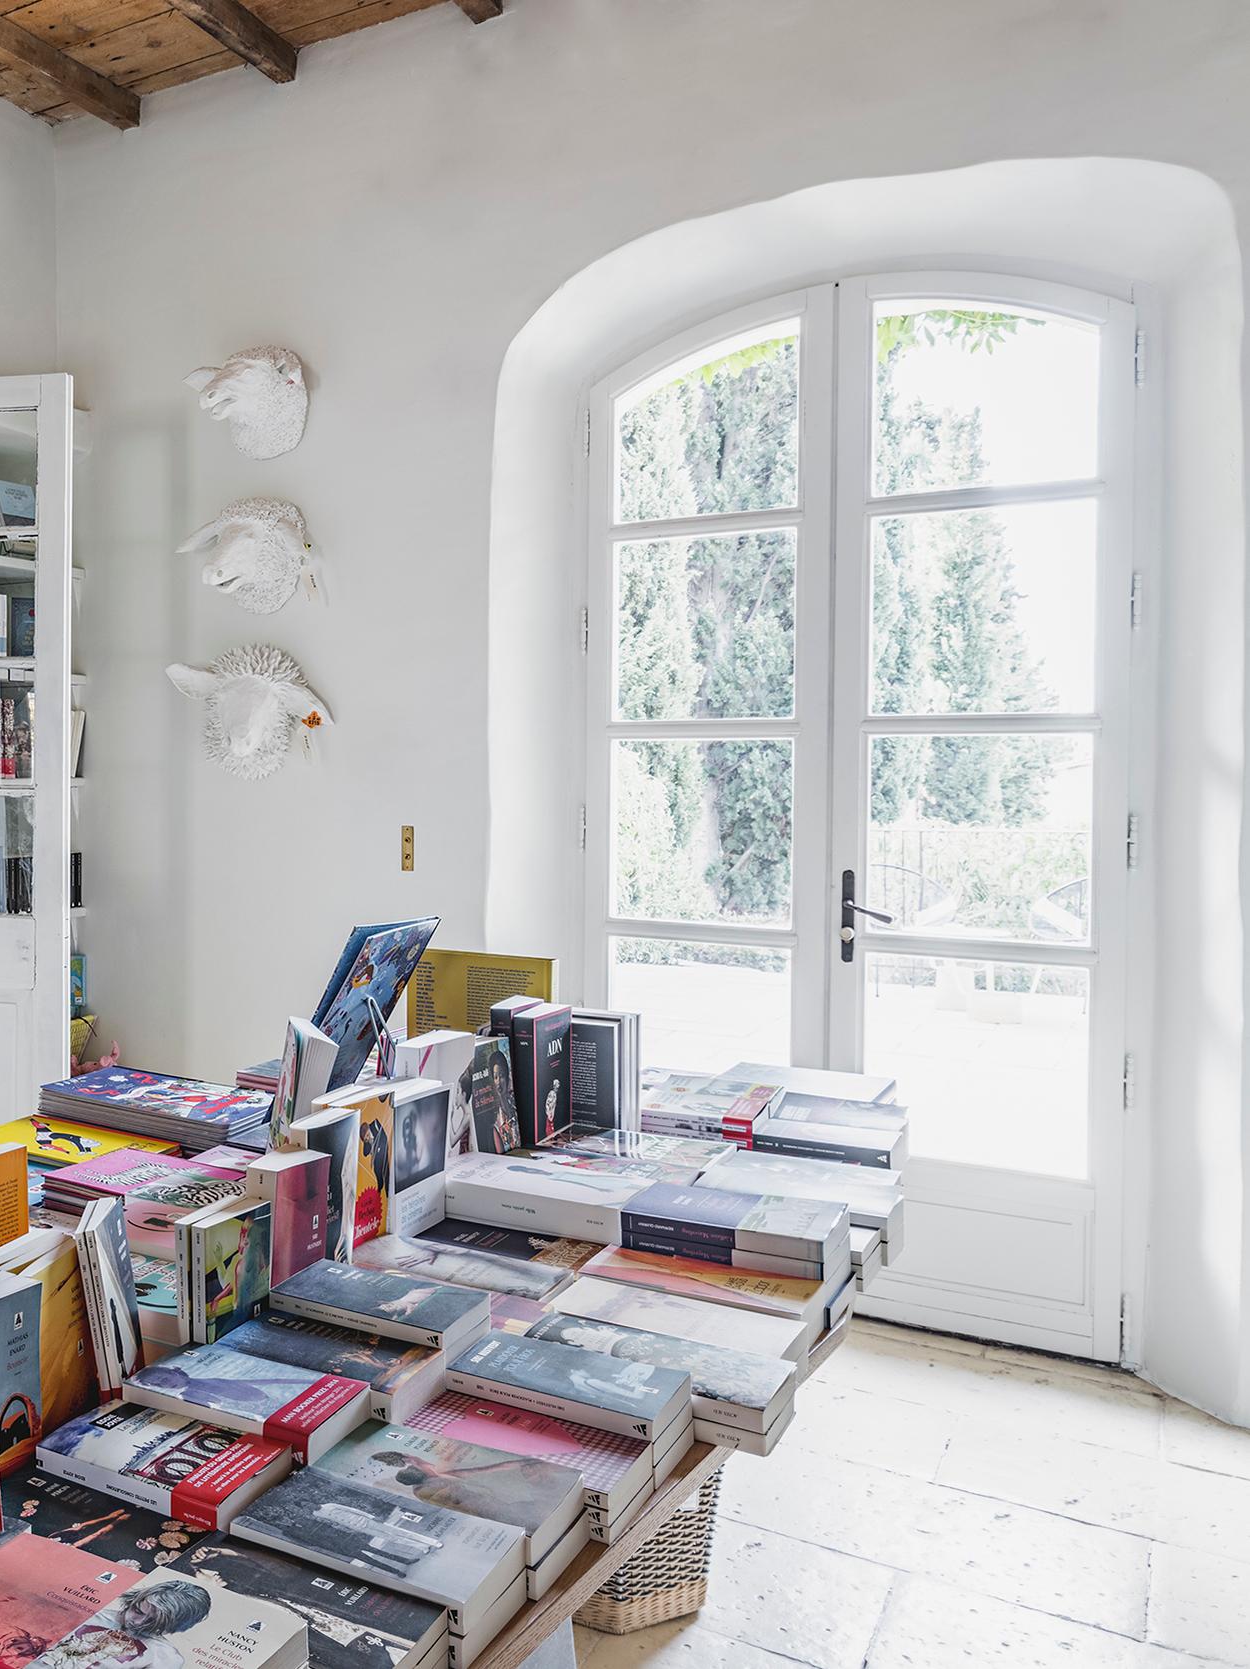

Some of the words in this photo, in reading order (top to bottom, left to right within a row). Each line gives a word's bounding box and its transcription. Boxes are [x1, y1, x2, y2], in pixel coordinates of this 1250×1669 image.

[547, 1037, 563, 1057] ADN
[354, 1216, 380, 1240] lientèle
[7, 1332, 29, 1346] MATHIAS
[470, 1351, 484, 1363] SIRI
[481, 1340, 501, 1355] HUSTVEDT
[281, 1412, 296, 1424] MAN
[293, 1397, 316, 1414] BOOKER
[312, 1387, 328, 1399] PRIZE
[104, 1416, 124, 1428] JOYCE
[229, 1443, 242, 1454] PRIX
[63, 1586, 101, 1604] VUILLARD
[80, 1583, 99, 1595] ÉRIC
[344, 1586, 370, 1606] VUILLARD
[216, 1635, 254, 1654] HUSTON
[226, 1629, 260, 1646] NANCY
[192, 1646, 207, 1659] des
[210, 1644, 223, 1654] Le
[220, 1647, 243, 1662] Club
